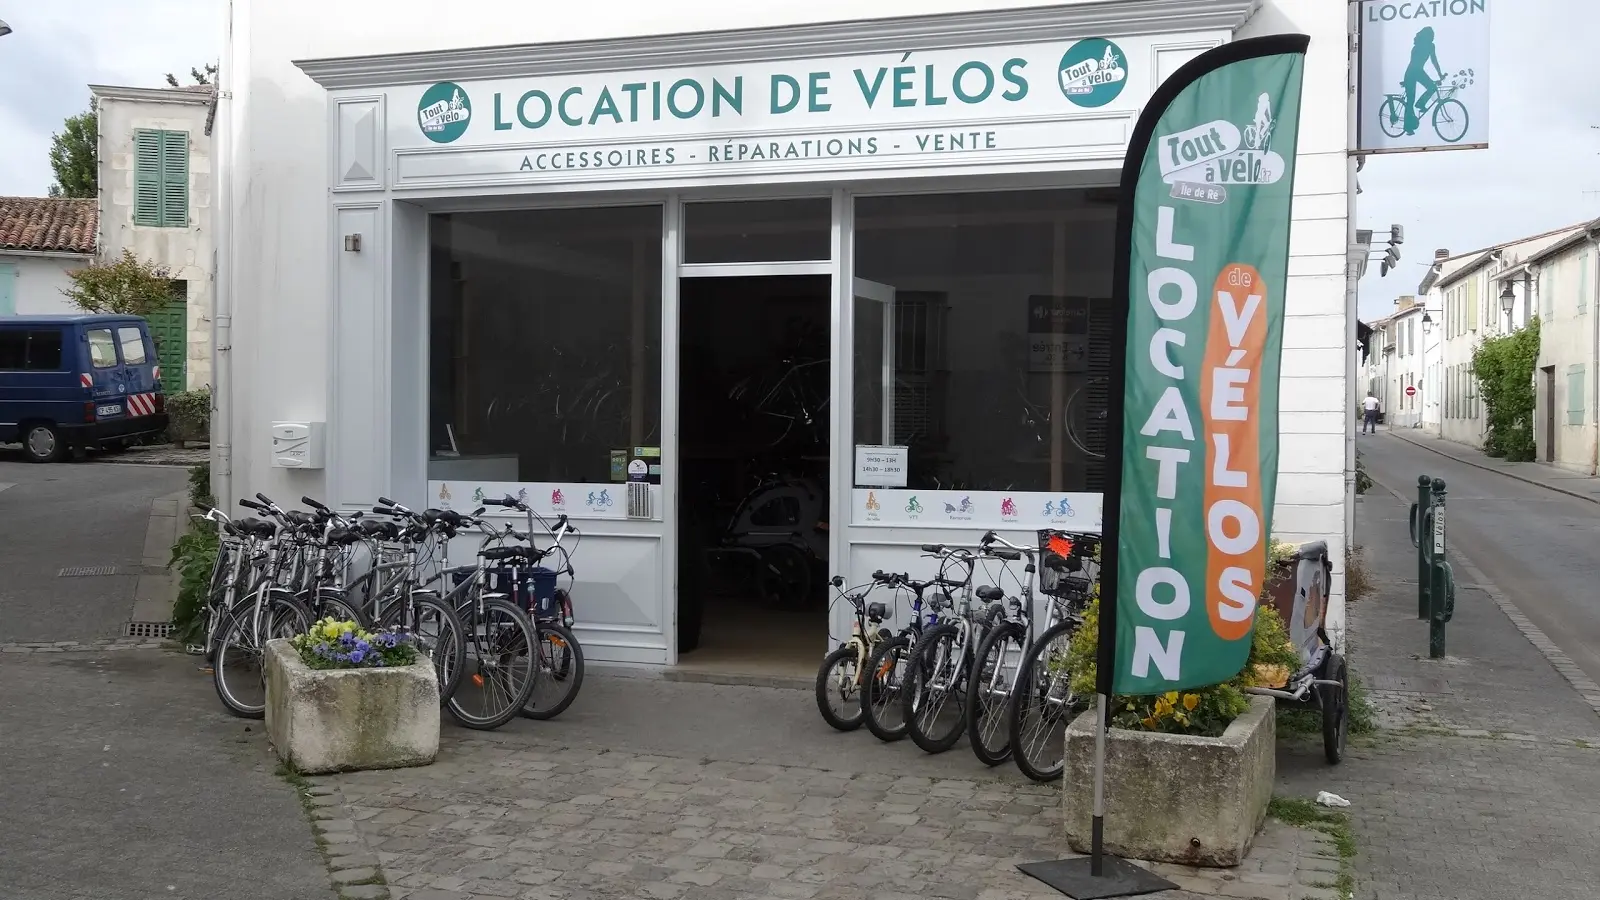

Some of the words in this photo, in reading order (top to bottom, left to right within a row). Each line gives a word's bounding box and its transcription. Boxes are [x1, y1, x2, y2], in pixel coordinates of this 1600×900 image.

[1369, 0, 1485, 22] LOCATION
[1065, 62, 1092, 81] Tout
[1088, 70, 1113, 85] vélo
[494, 76, 743, 131] LOCATION
[770, 72, 832, 114] DE
[853, 52, 1029, 110] VÉLOS
[423, 103, 444, 120] Tout
[520, 147, 675, 171] ACCESSOIRES
[709, 136, 878, 162] RÉPARATIONS
[916, 131, 996, 151] VENTE
[1167, 127, 1227, 167] Tout
[1194, 186, 1205, 198] de
[1207, 188, 1219, 200] Ré
[1228, 268, 1252, 287] de
[1130, 206, 1198, 681] LOCATION
[1208, 291, 1262, 622] VÉLOS
